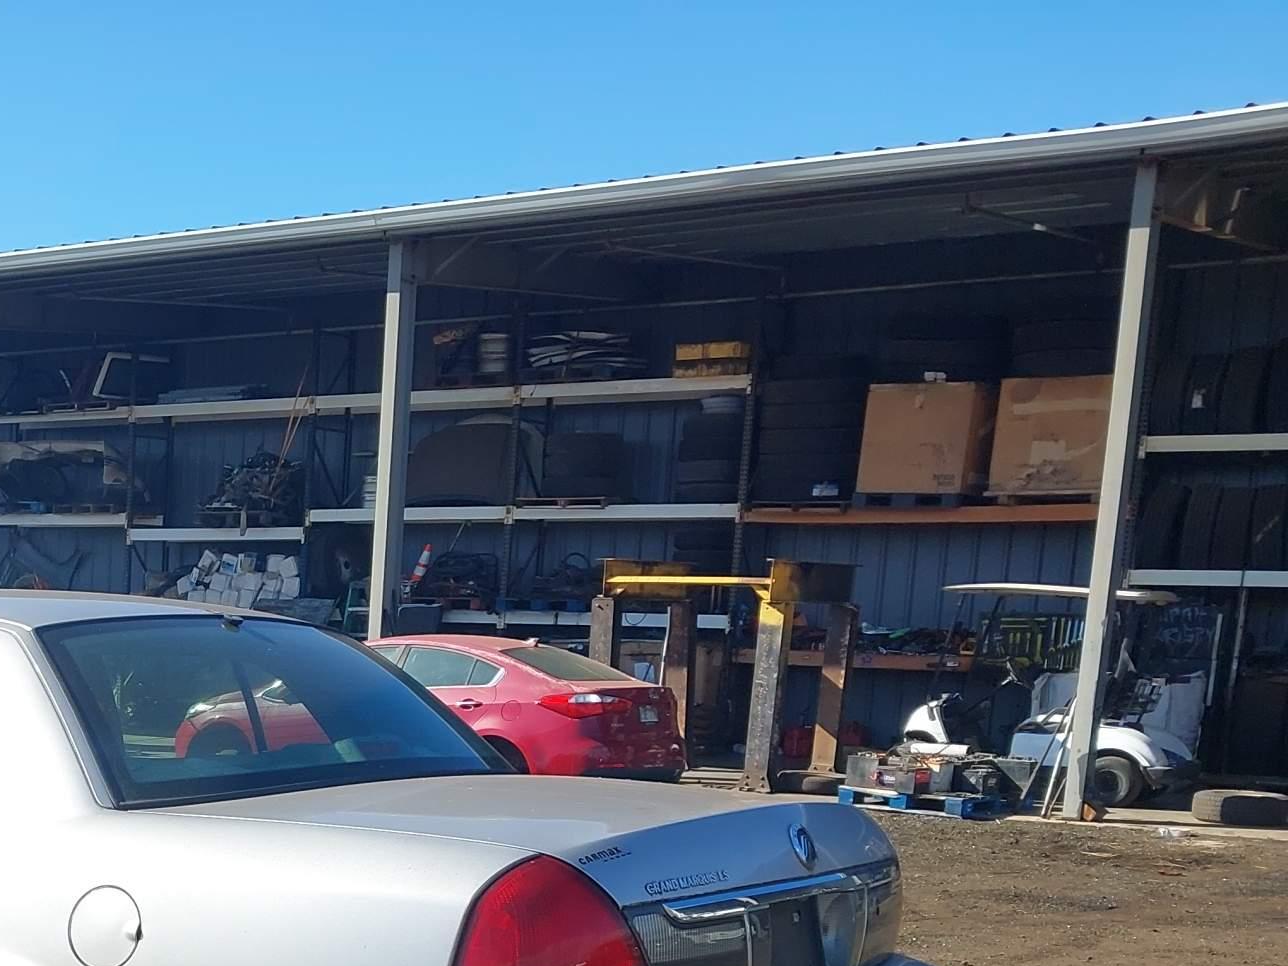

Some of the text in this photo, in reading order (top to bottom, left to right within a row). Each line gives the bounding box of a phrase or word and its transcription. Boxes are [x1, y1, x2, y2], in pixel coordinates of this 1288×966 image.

[644, 870, 731, 896] GRAND MARQUIS LS
